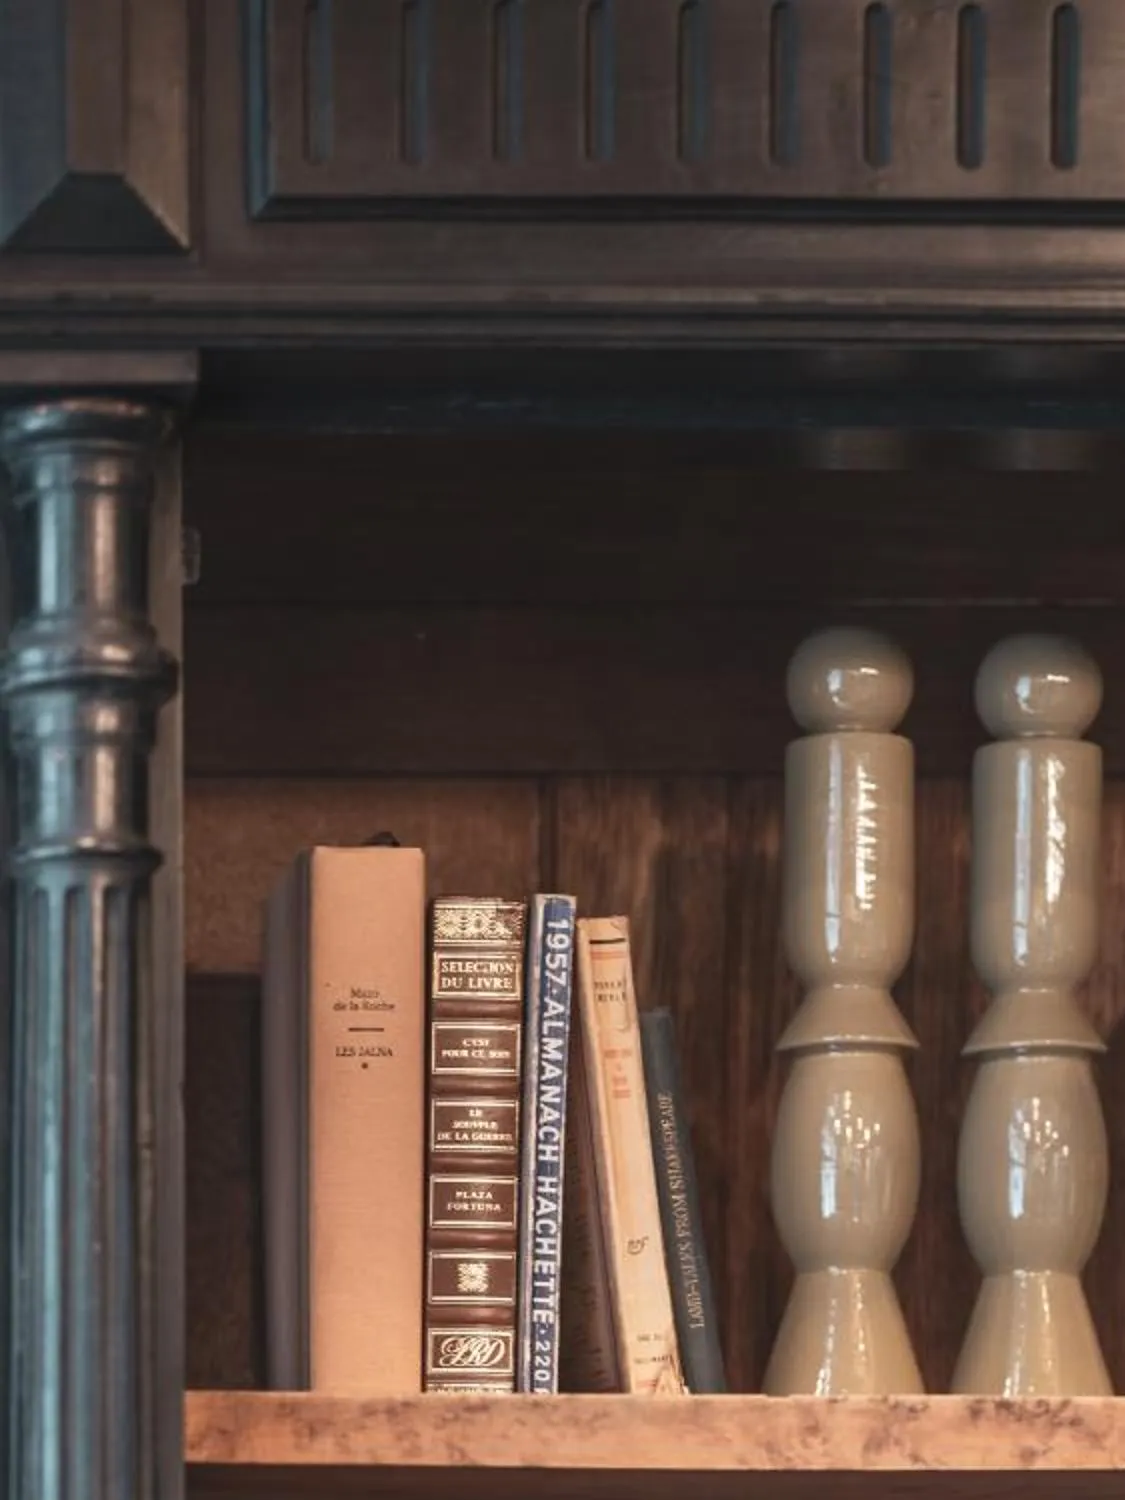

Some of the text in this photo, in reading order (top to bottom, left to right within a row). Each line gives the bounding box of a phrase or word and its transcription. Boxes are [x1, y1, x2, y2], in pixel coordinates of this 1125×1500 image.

[543, 919, 571, 988] 1957
[441, 977, 513, 989] DU LIVRE
[537, 997, 570, 1162] ALMANACH
[455, 1132, 469, 1141] LA
[456, 1191, 493, 1200] PLAZA
[532, 1176, 558, 1324] HACHETTE
[534, 1340, 551, 1381] 220
